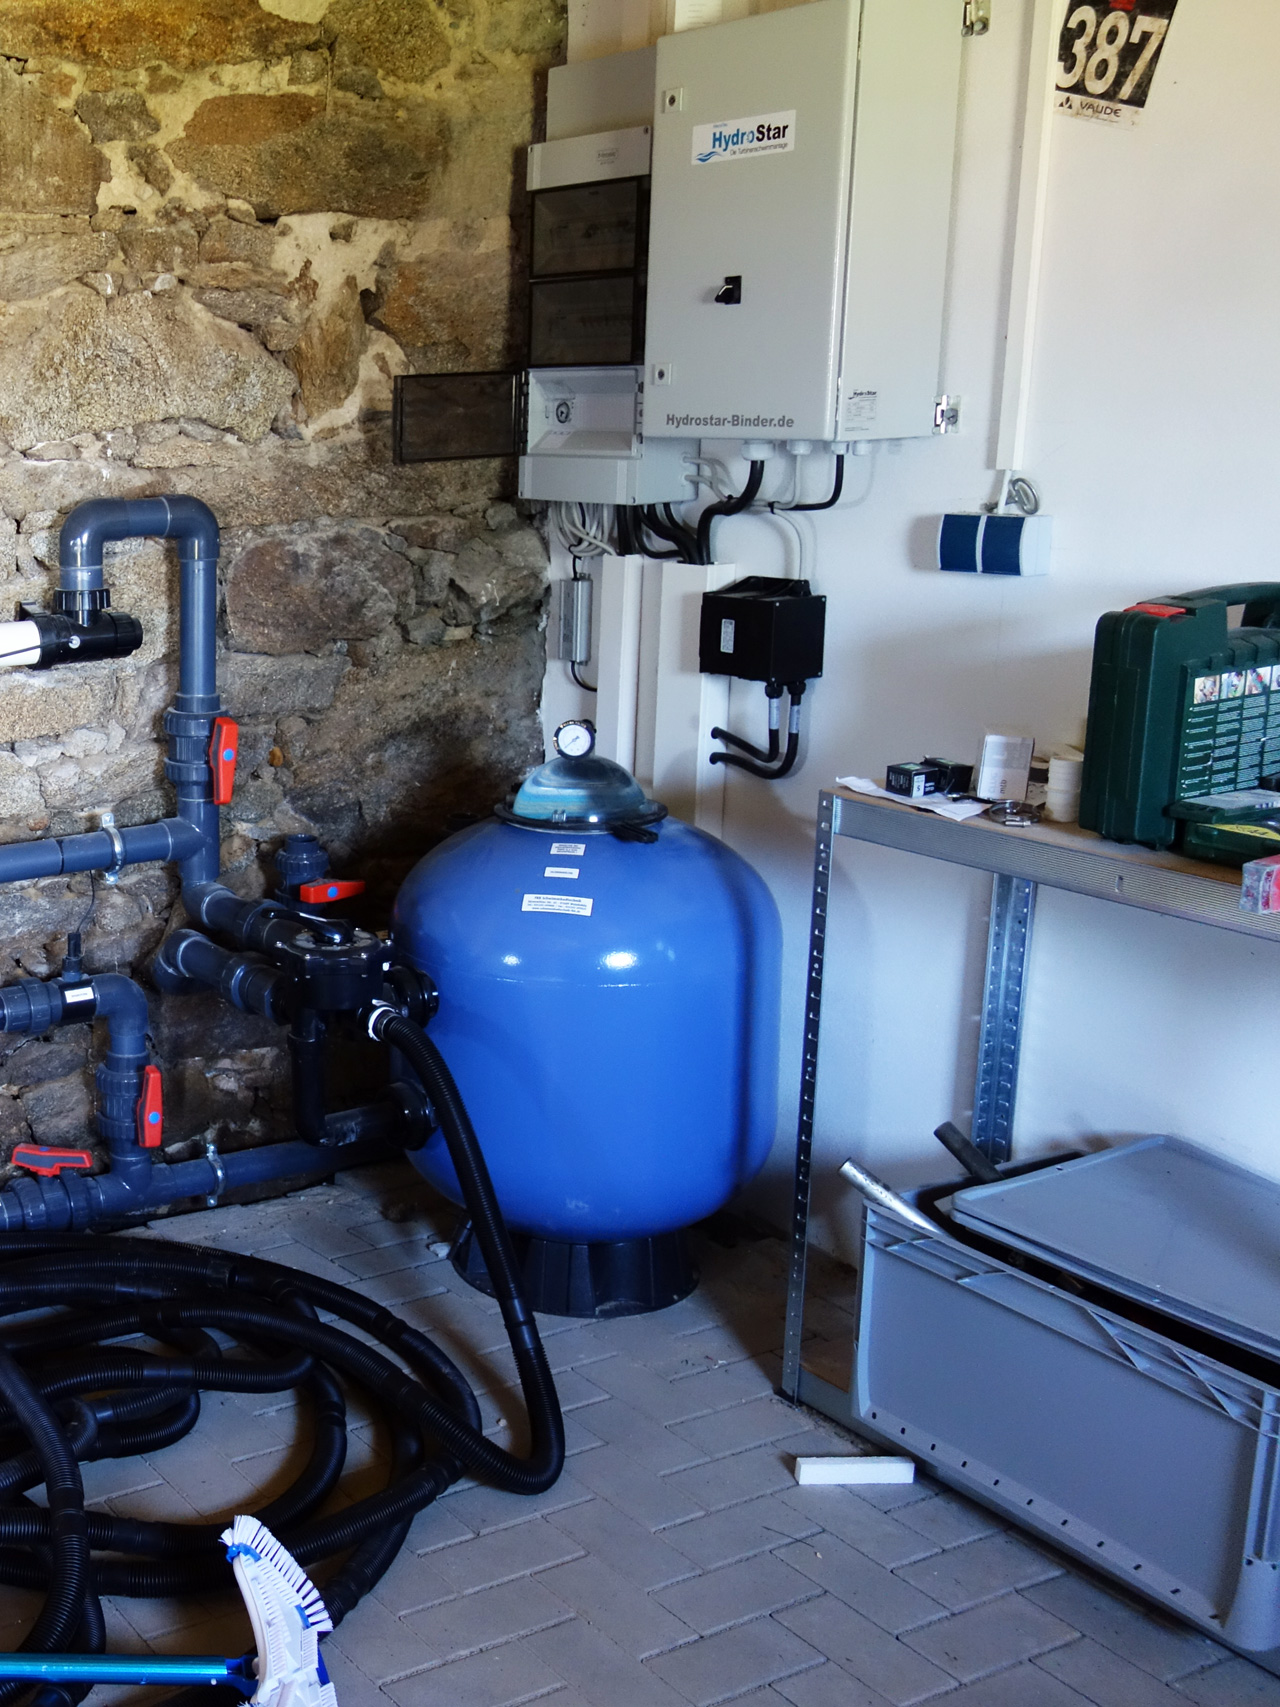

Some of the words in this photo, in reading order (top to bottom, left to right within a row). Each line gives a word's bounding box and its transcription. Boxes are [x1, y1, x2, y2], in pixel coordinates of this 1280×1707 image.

[1056, 5, 1169, 100] 387
[1079, 101, 1122, 118] VAUDE
[711, 123, 789, 152] HydroStar
[666, 413, 795, 428] Hydrostar-Binder.de
